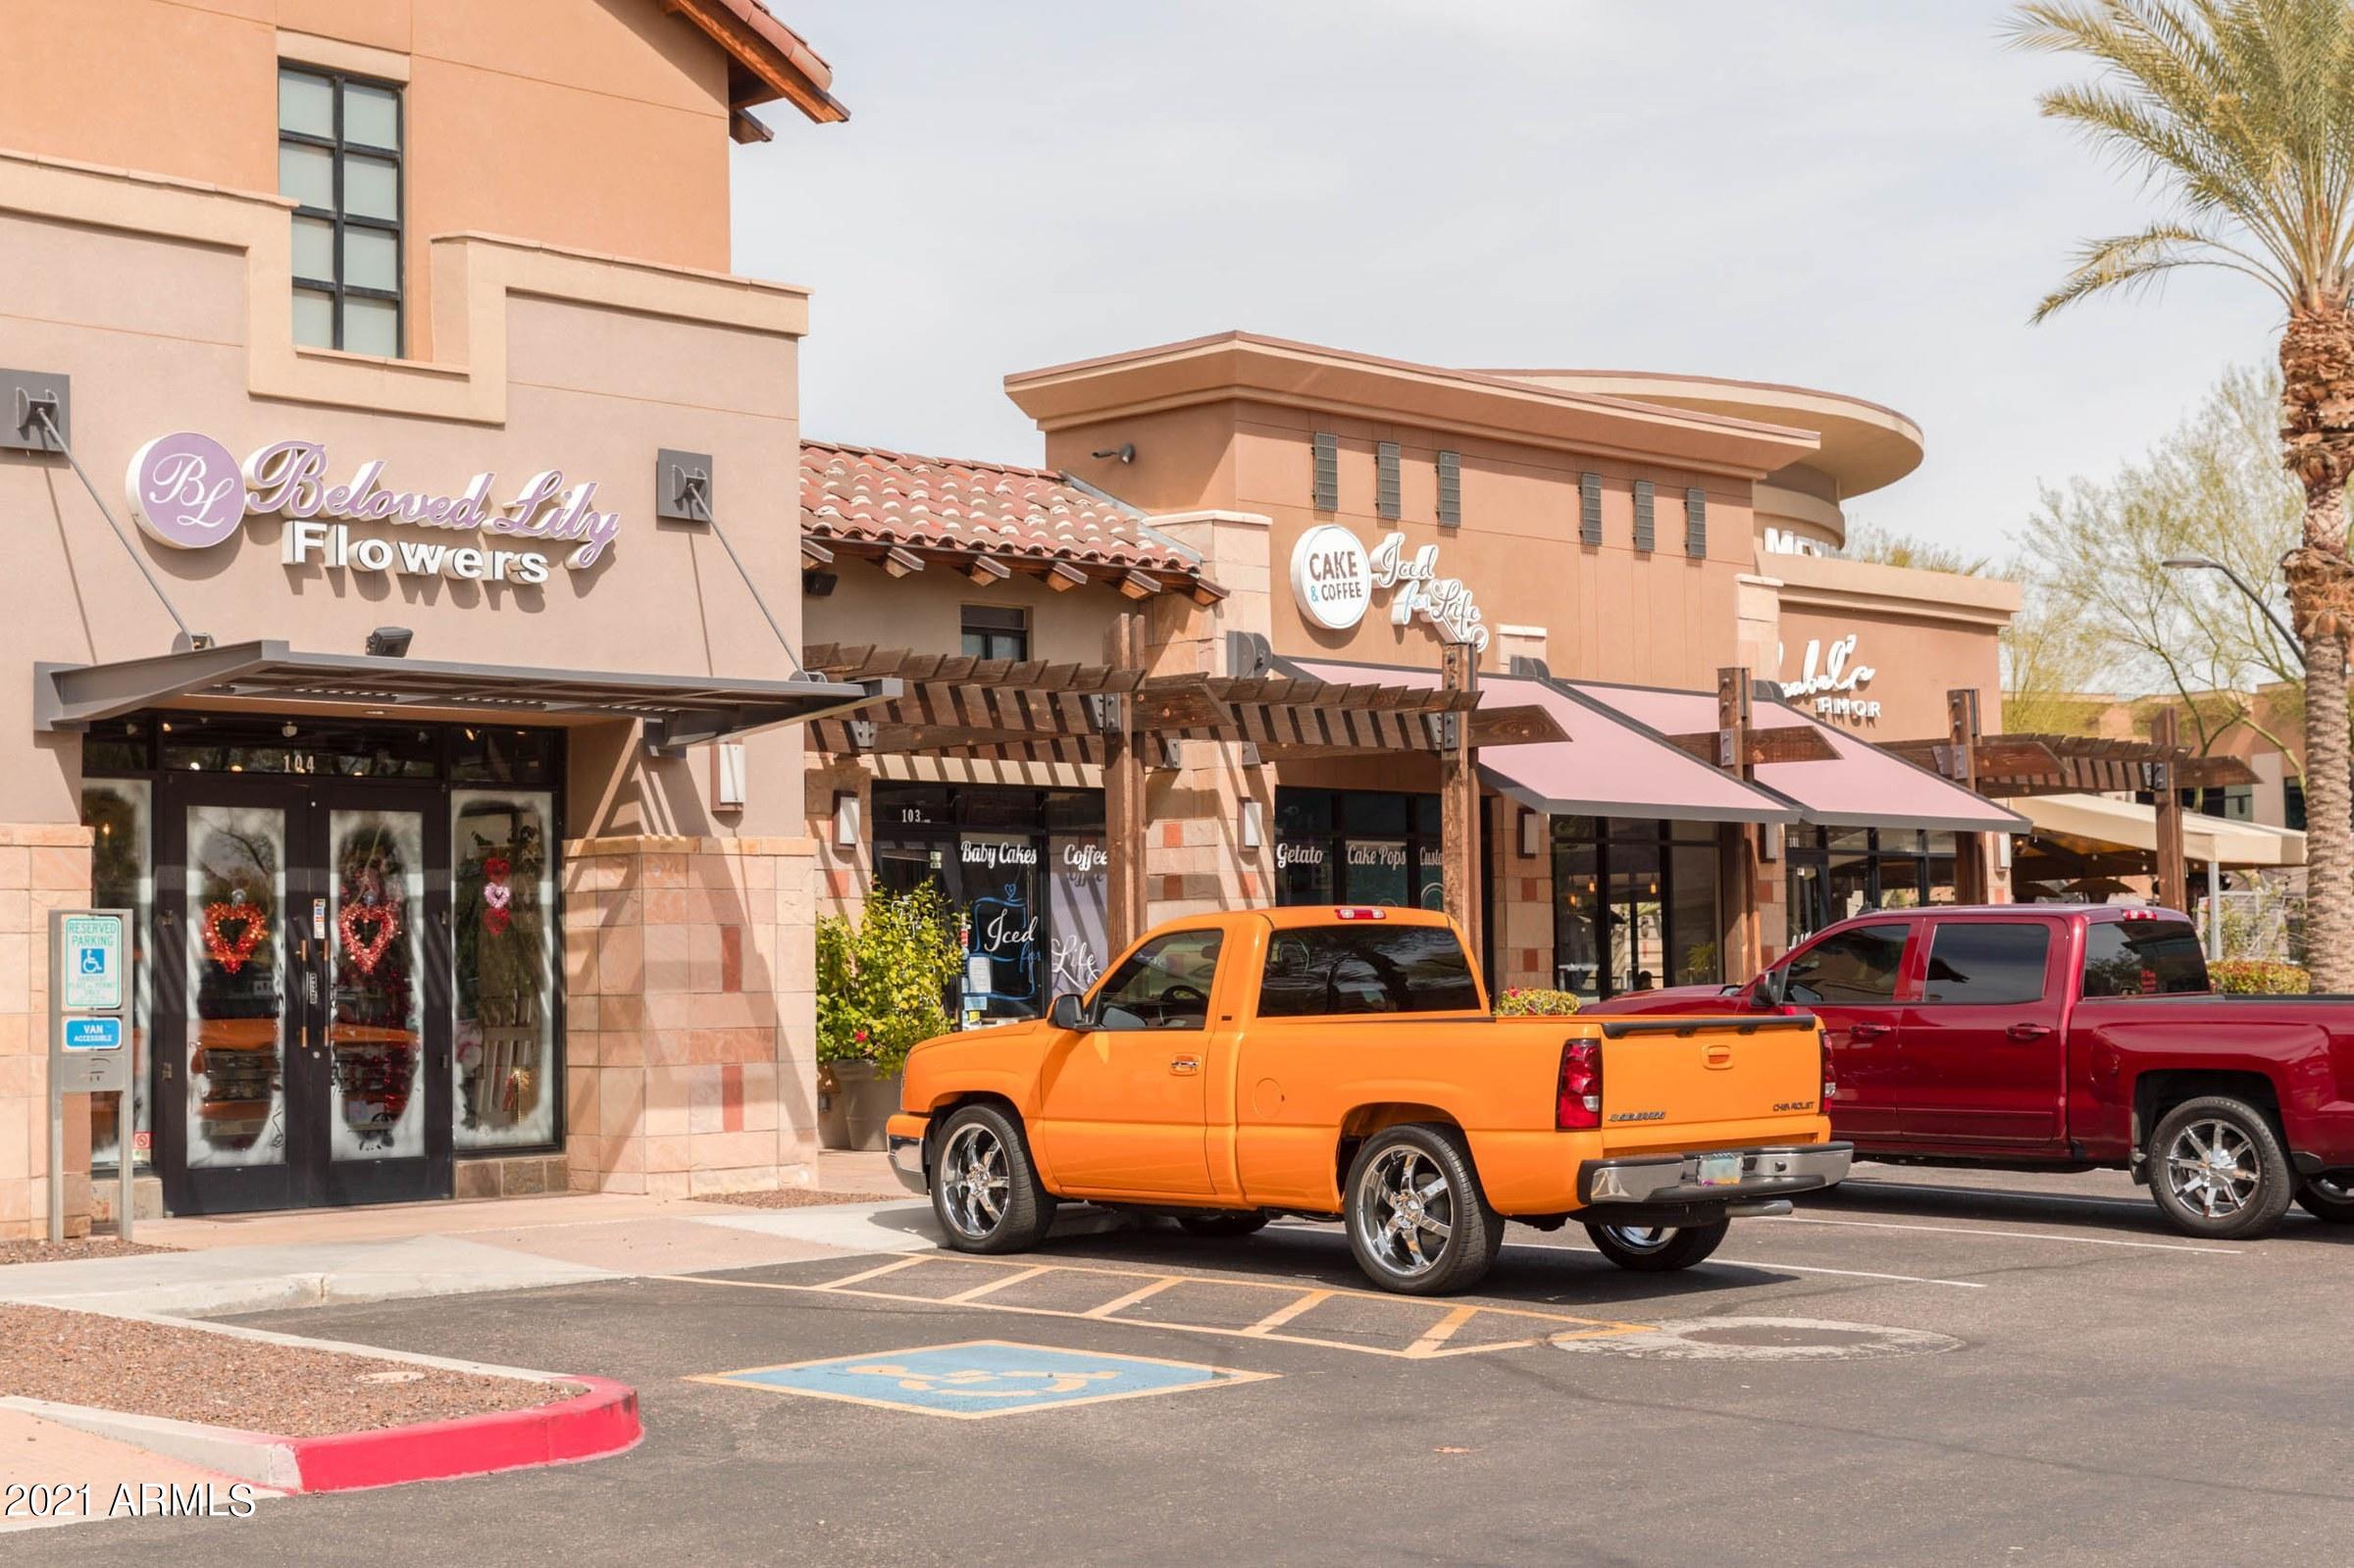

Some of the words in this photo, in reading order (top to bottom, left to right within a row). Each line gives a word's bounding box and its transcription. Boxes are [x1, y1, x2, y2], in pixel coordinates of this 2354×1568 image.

[249, 440, 494, 530] Beloved
[492, 470, 620, 567] Lily
[281, 521, 549, 585] Flowers
[1309, 551, 1358, 581] CAKE
[1377, 533, 1439, 586] Iced
[1310, 585, 1319, 603] &
[1321, 582, 1362, 602] COFFEE
[1402, 579, 1430, 624] for
[1431, 579, 1483, 643] Life
[1815, 696, 1881, 718] AMOR
[283, 754, 315, 774] 104
[901, 809, 921, 823] 103
[961, 840, 996, 869] Baby
[998, 841, 1038, 864] Cakes
[1063, 843, 1107, 871] Coffee
[1276, 842, 1323, 869] Gelato
[1347, 844, 1376, 865] Cake
[1378, 845, 1407, 871] Pops
[68, 923, 118, 935] RESERVED
[72, 935, 116, 946] PARKING
[984, 908, 1039, 952] Iced
[1050, 934, 1100, 988] Life
[83, 1024, 104, 1035] VAN
